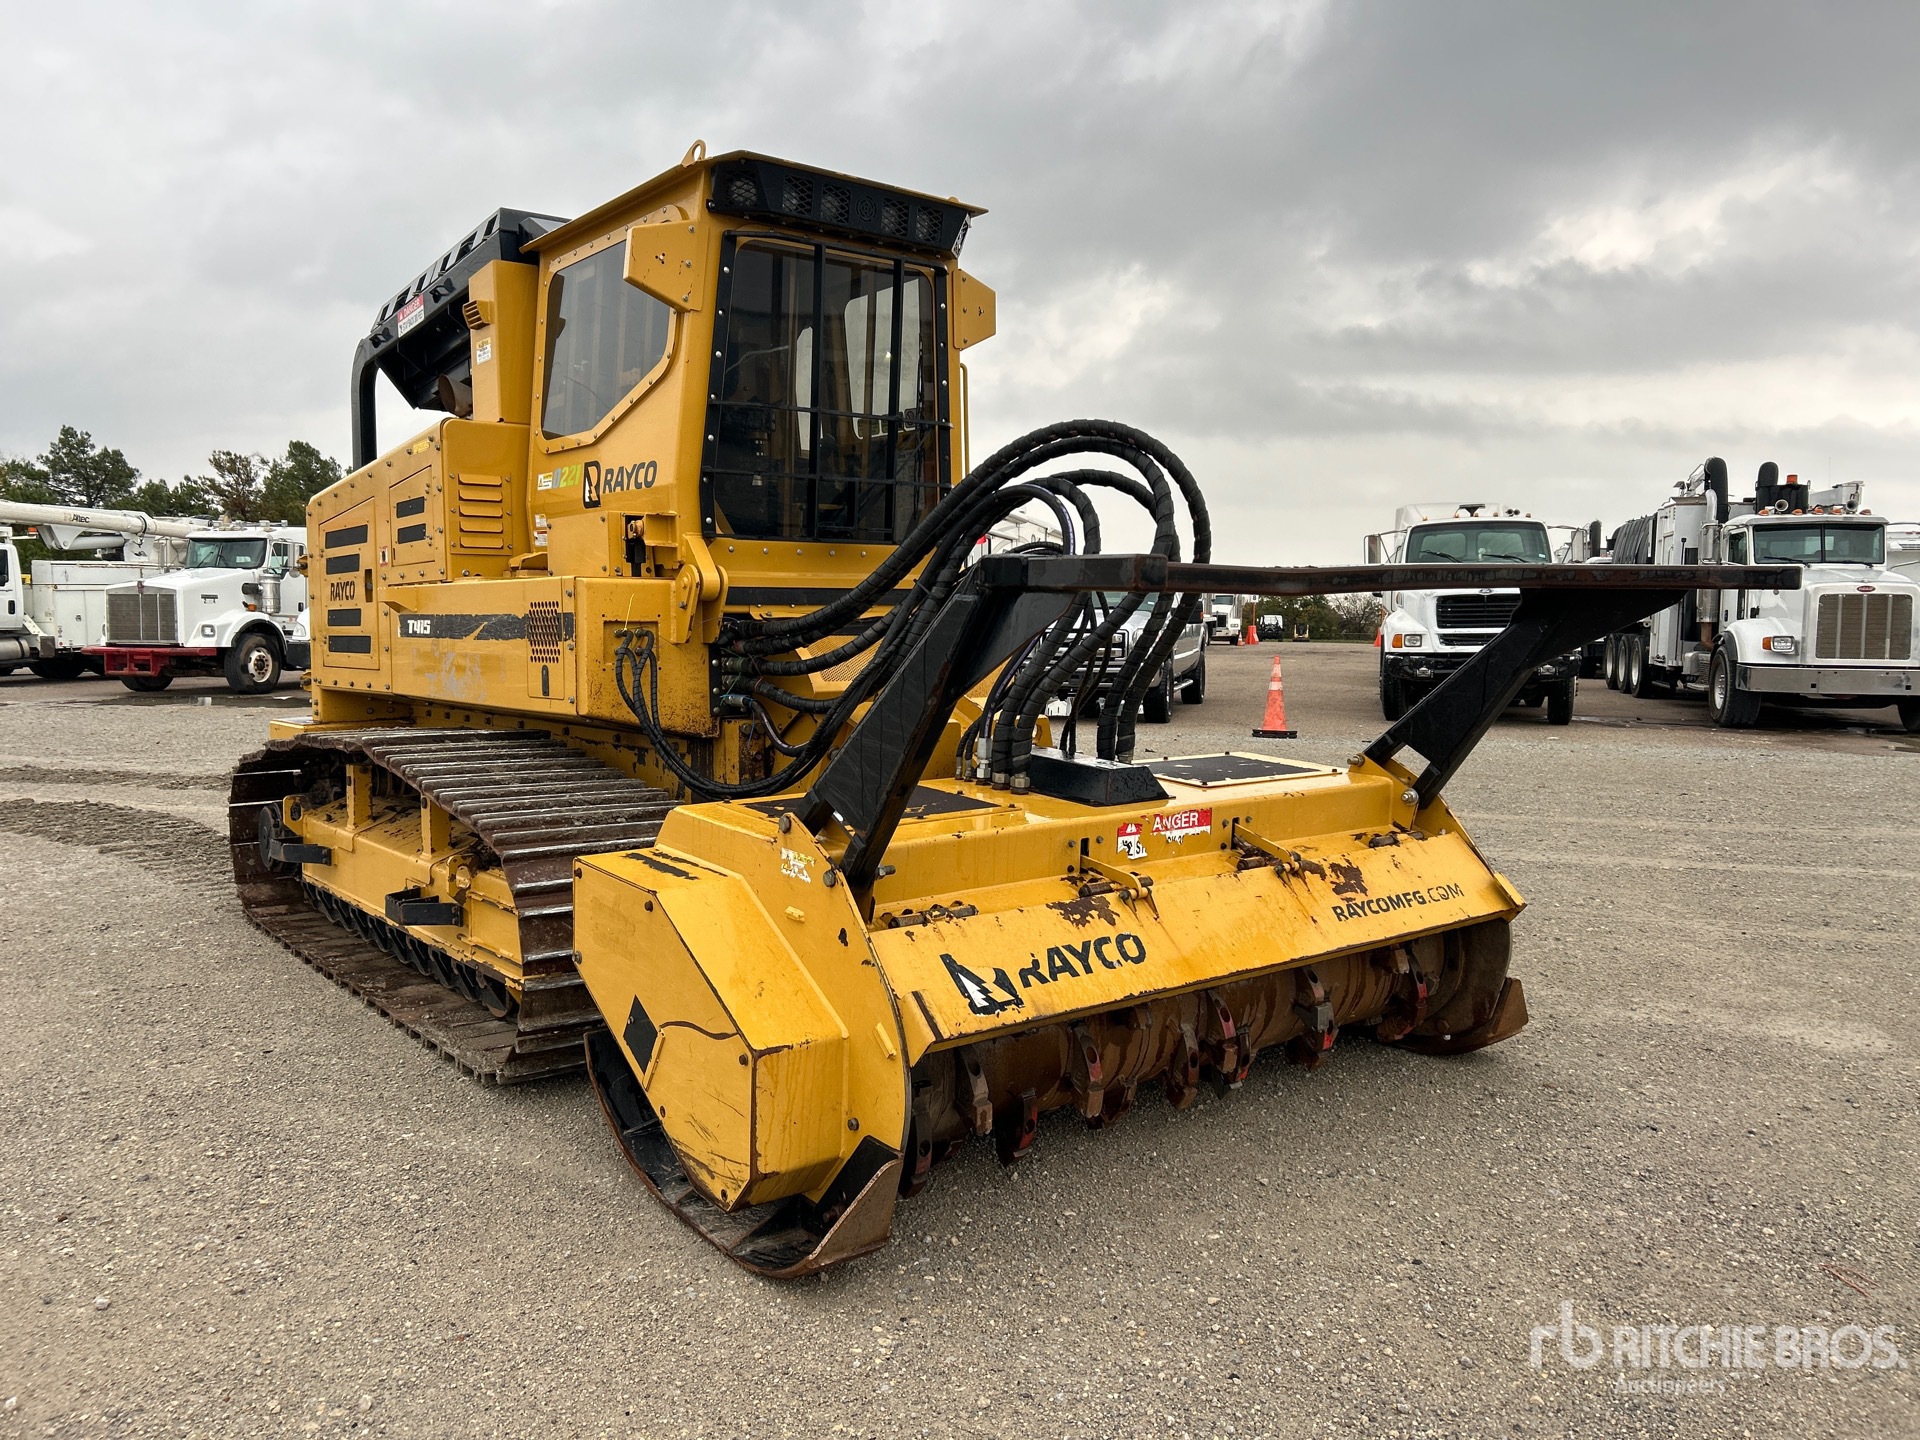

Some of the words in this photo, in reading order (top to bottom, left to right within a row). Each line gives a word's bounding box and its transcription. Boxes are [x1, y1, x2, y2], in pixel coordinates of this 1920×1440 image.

[603, 460, 658, 494] RAYCO
[330, 580, 356, 601] RAYCO
[407, 619, 431, 635] T415
[1152, 811, 1199, 831] ANGER
[1331, 882, 1465, 922] RAYCOMFG.COM
[1018, 932, 1147, 989] RAYCO
